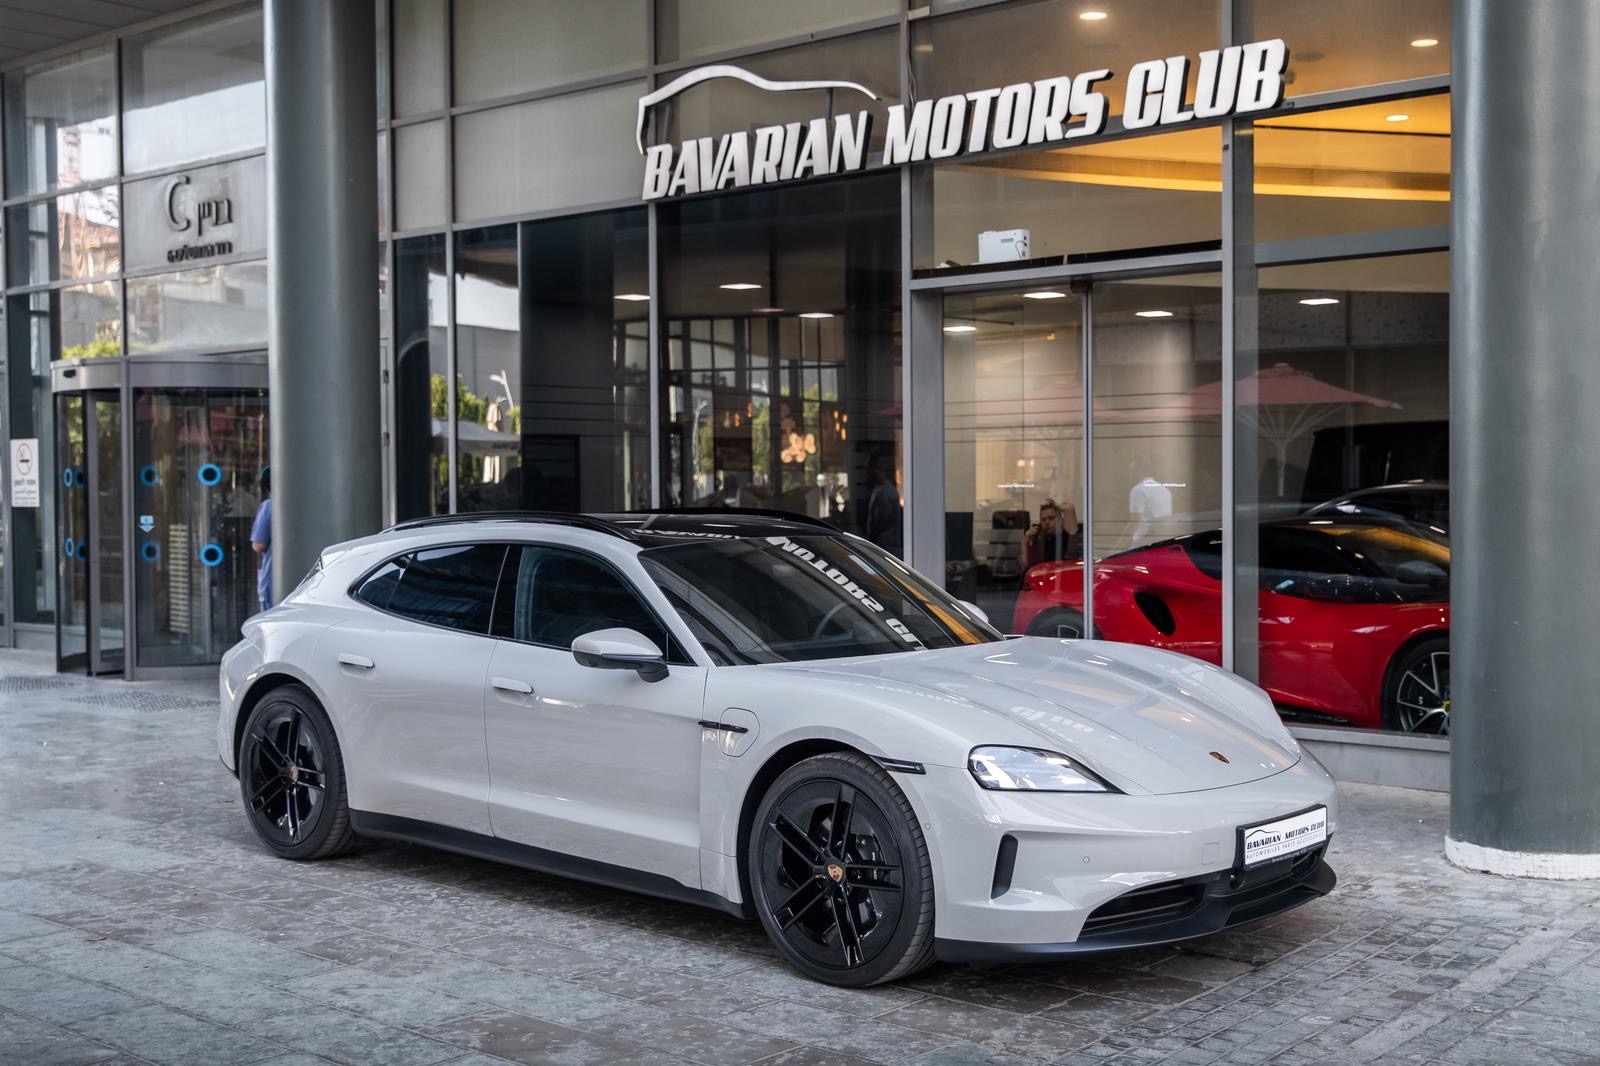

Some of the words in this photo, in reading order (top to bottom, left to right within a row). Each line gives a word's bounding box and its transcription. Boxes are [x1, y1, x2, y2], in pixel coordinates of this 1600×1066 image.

[642, 110, 872, 200] BAVARIAN
[883, 68, 1112, 164] MOTORS
[1122, 39, 1289, 130] CLUB
[164, 175, 191, 232] C
[1247, 835, 1281, 850] BAVARIAN
[1285, 826, 1309, 838] MOTORS
[1310, 821, 1325, 831] CLUB
